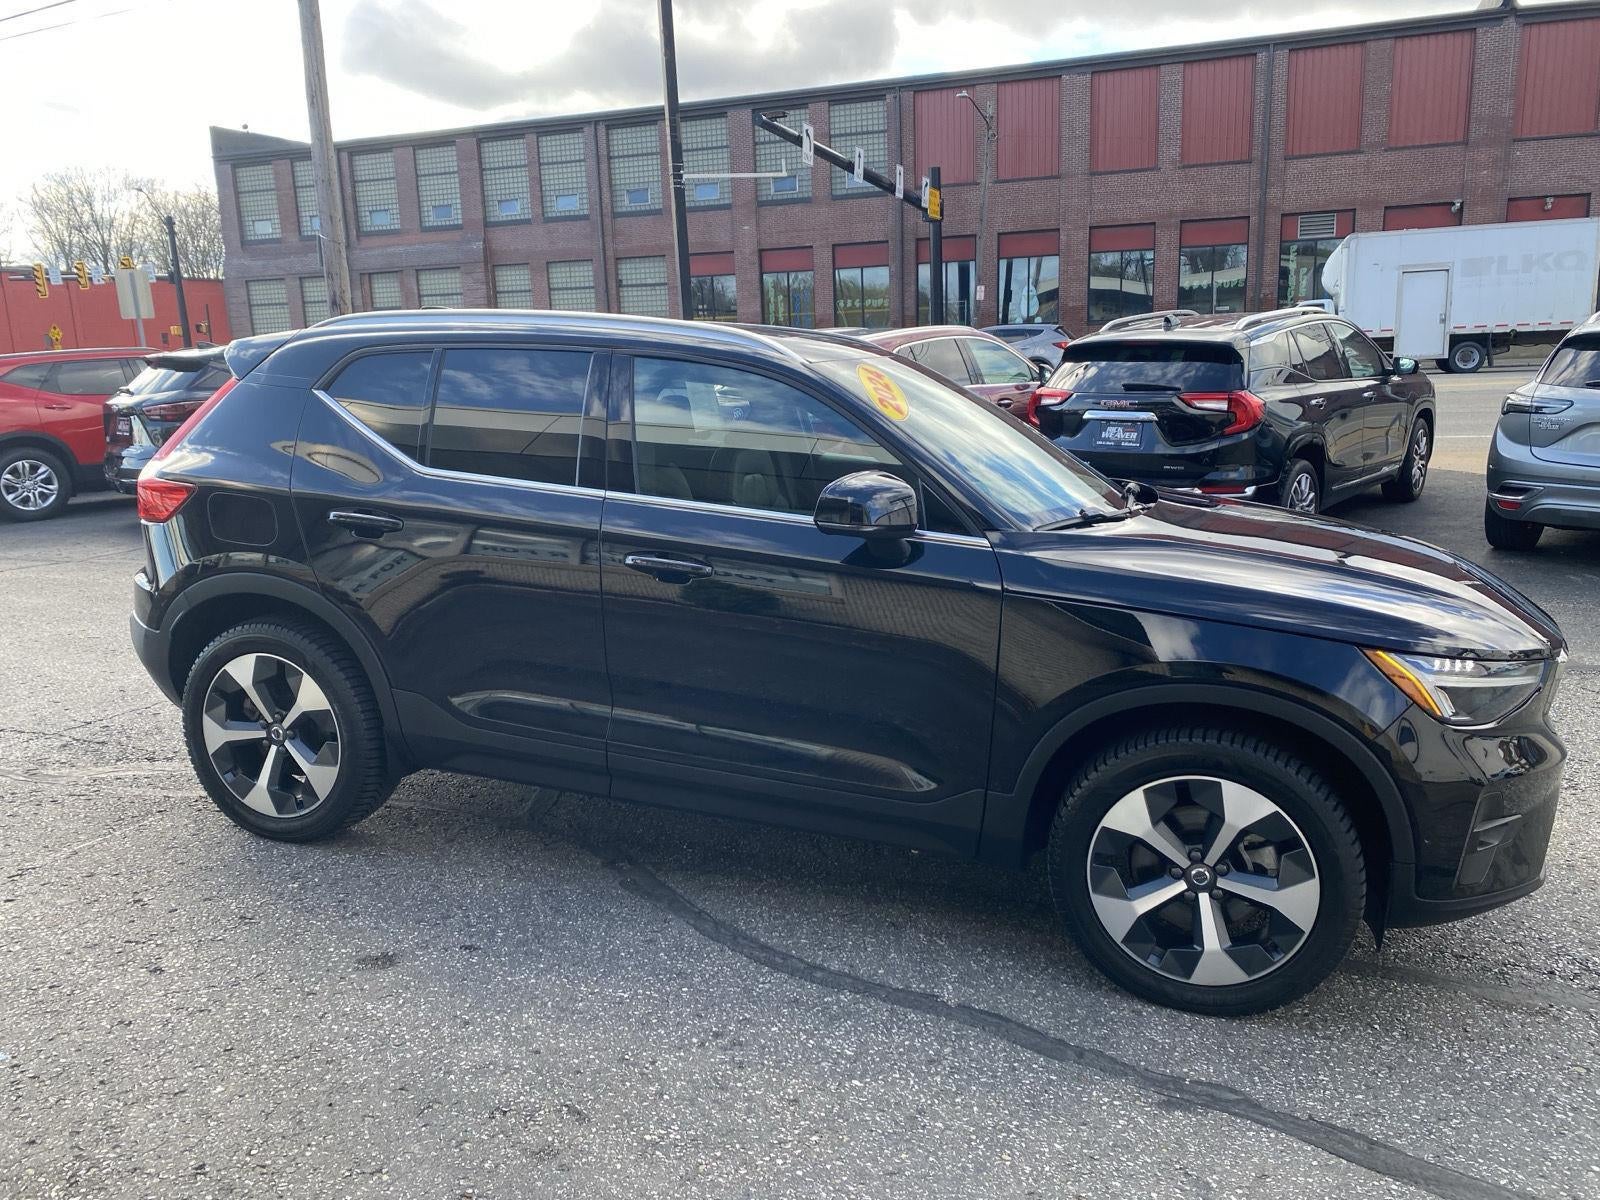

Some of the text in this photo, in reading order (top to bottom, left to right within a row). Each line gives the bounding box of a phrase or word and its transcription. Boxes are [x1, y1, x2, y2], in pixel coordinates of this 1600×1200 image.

[861, 366, 907, 417] 2024
[1100, 400, 1138, 408] GMC
[1101, 430, 1137, 438] WEAVER
